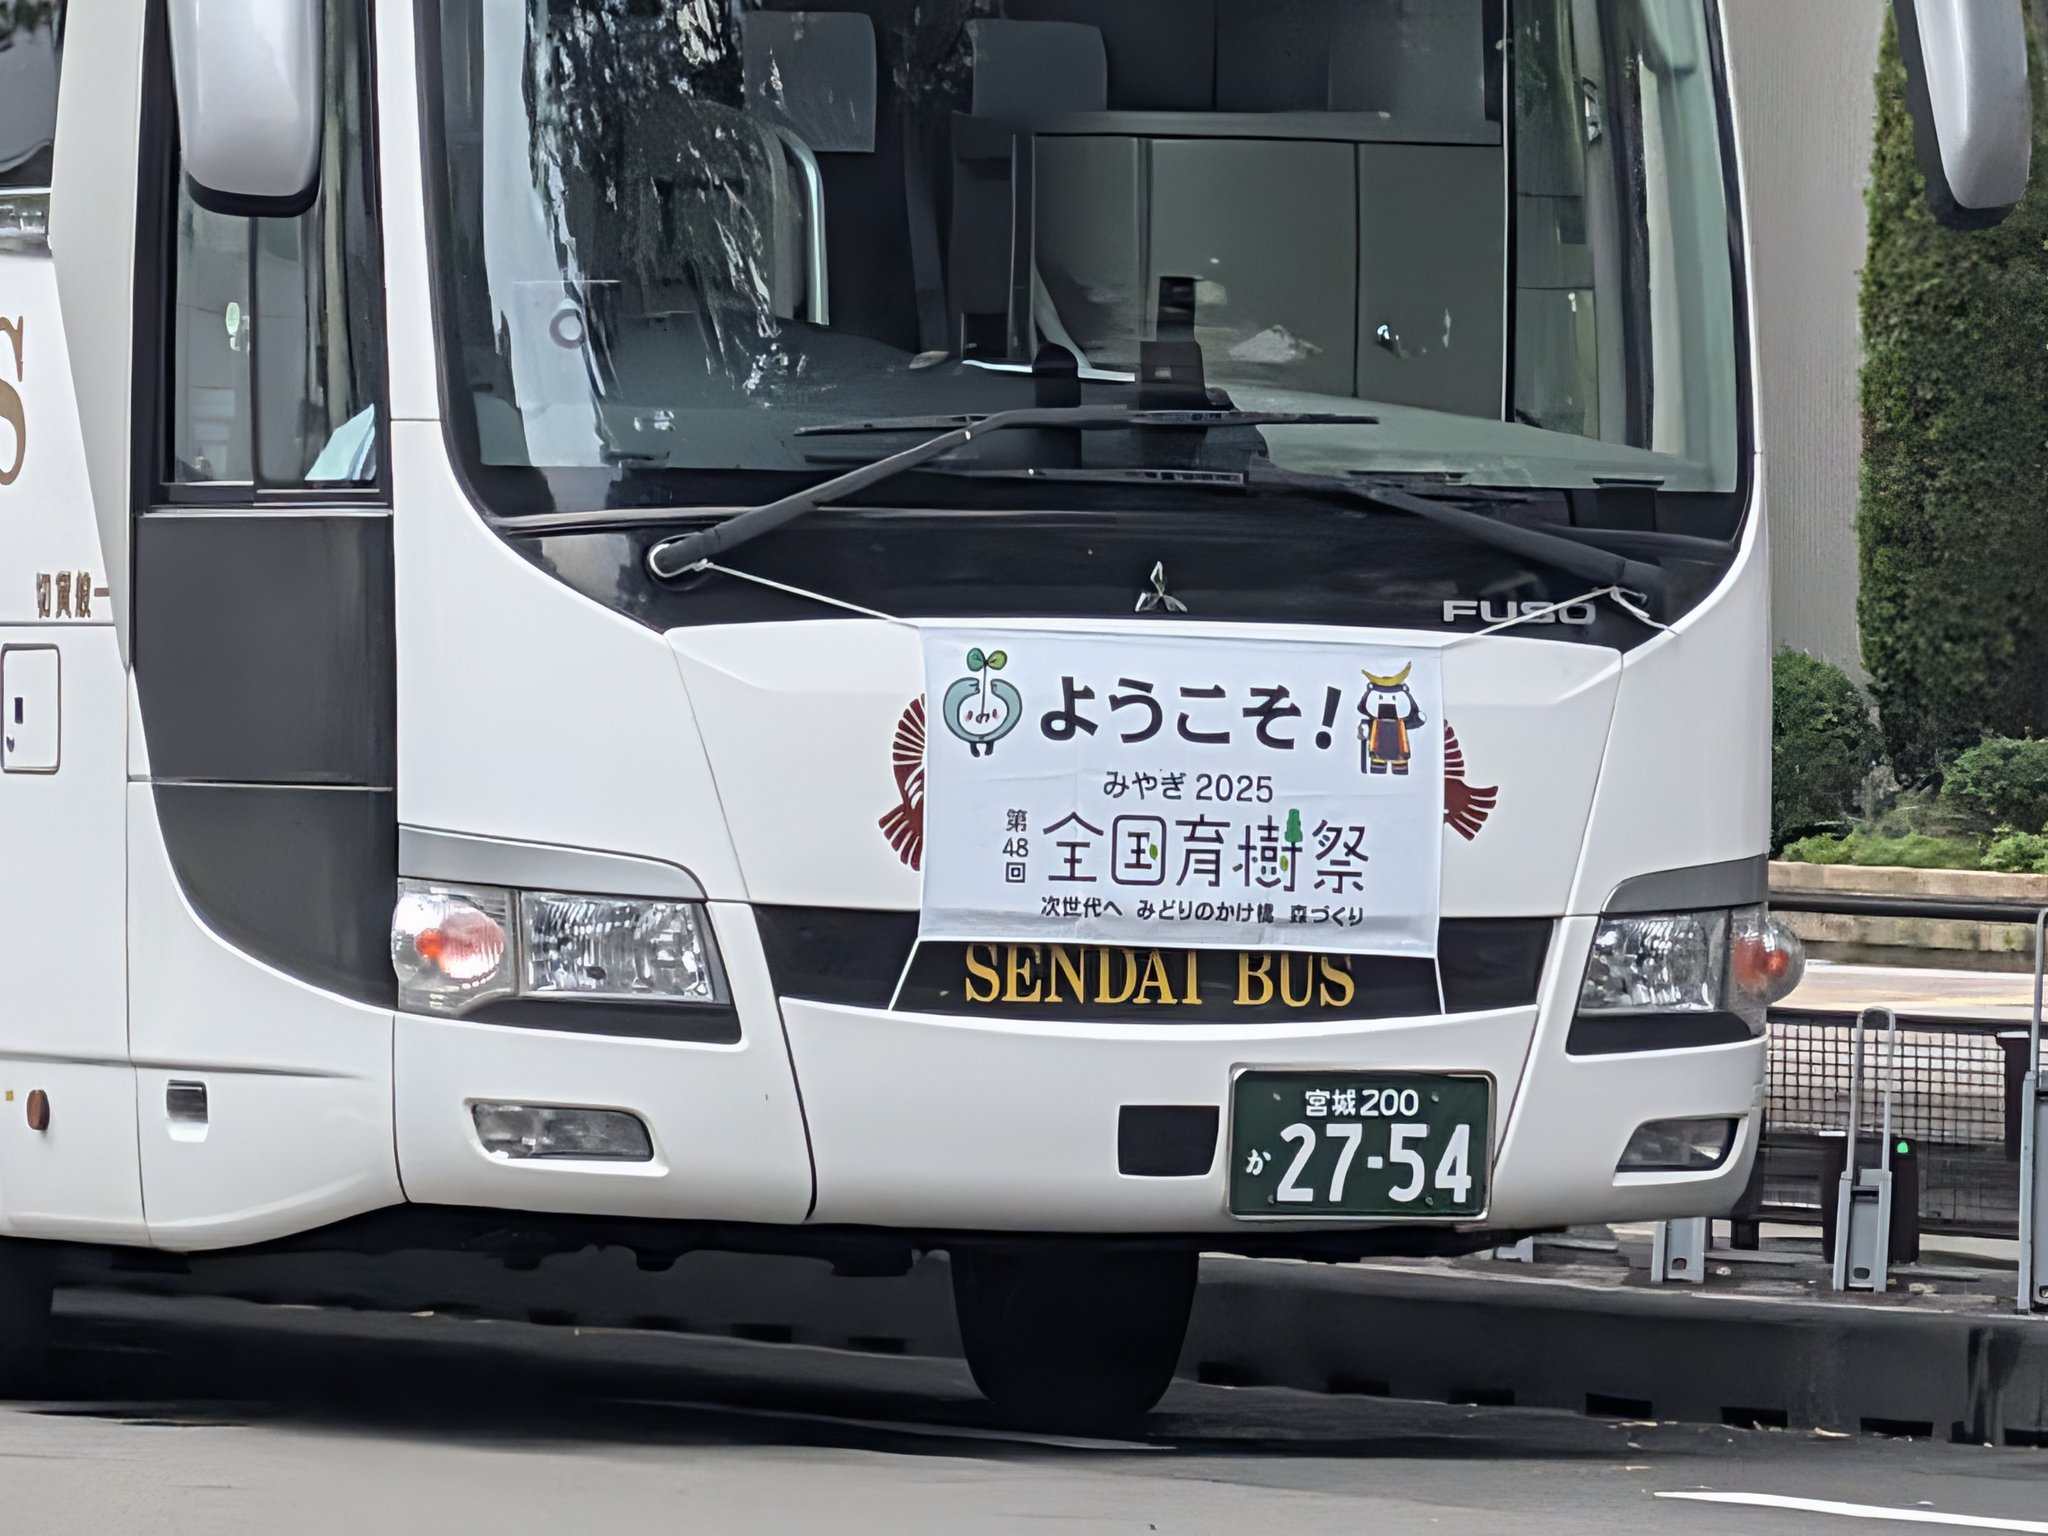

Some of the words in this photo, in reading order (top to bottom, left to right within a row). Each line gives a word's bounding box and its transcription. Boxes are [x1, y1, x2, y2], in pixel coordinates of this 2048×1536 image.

[1443, 600, 1596, 625] FUSO
[1040, 676, 1342, 750] ようこそ!
[1103, 770, 1187, 800] みやぎ
[1195, 774, 1274, 803] 2025
[1042, 808, 1369, 894] 全国育樹祭
[1040, 896, 1123, 918] 次世代へ
[965, 943, 1203, 1004] SENDAI
[1233, 950, 1356, 1008] BUS
[1245, 1148, 1272, 1176] か
[1276, 1122, 1472, 1203] 27-54
